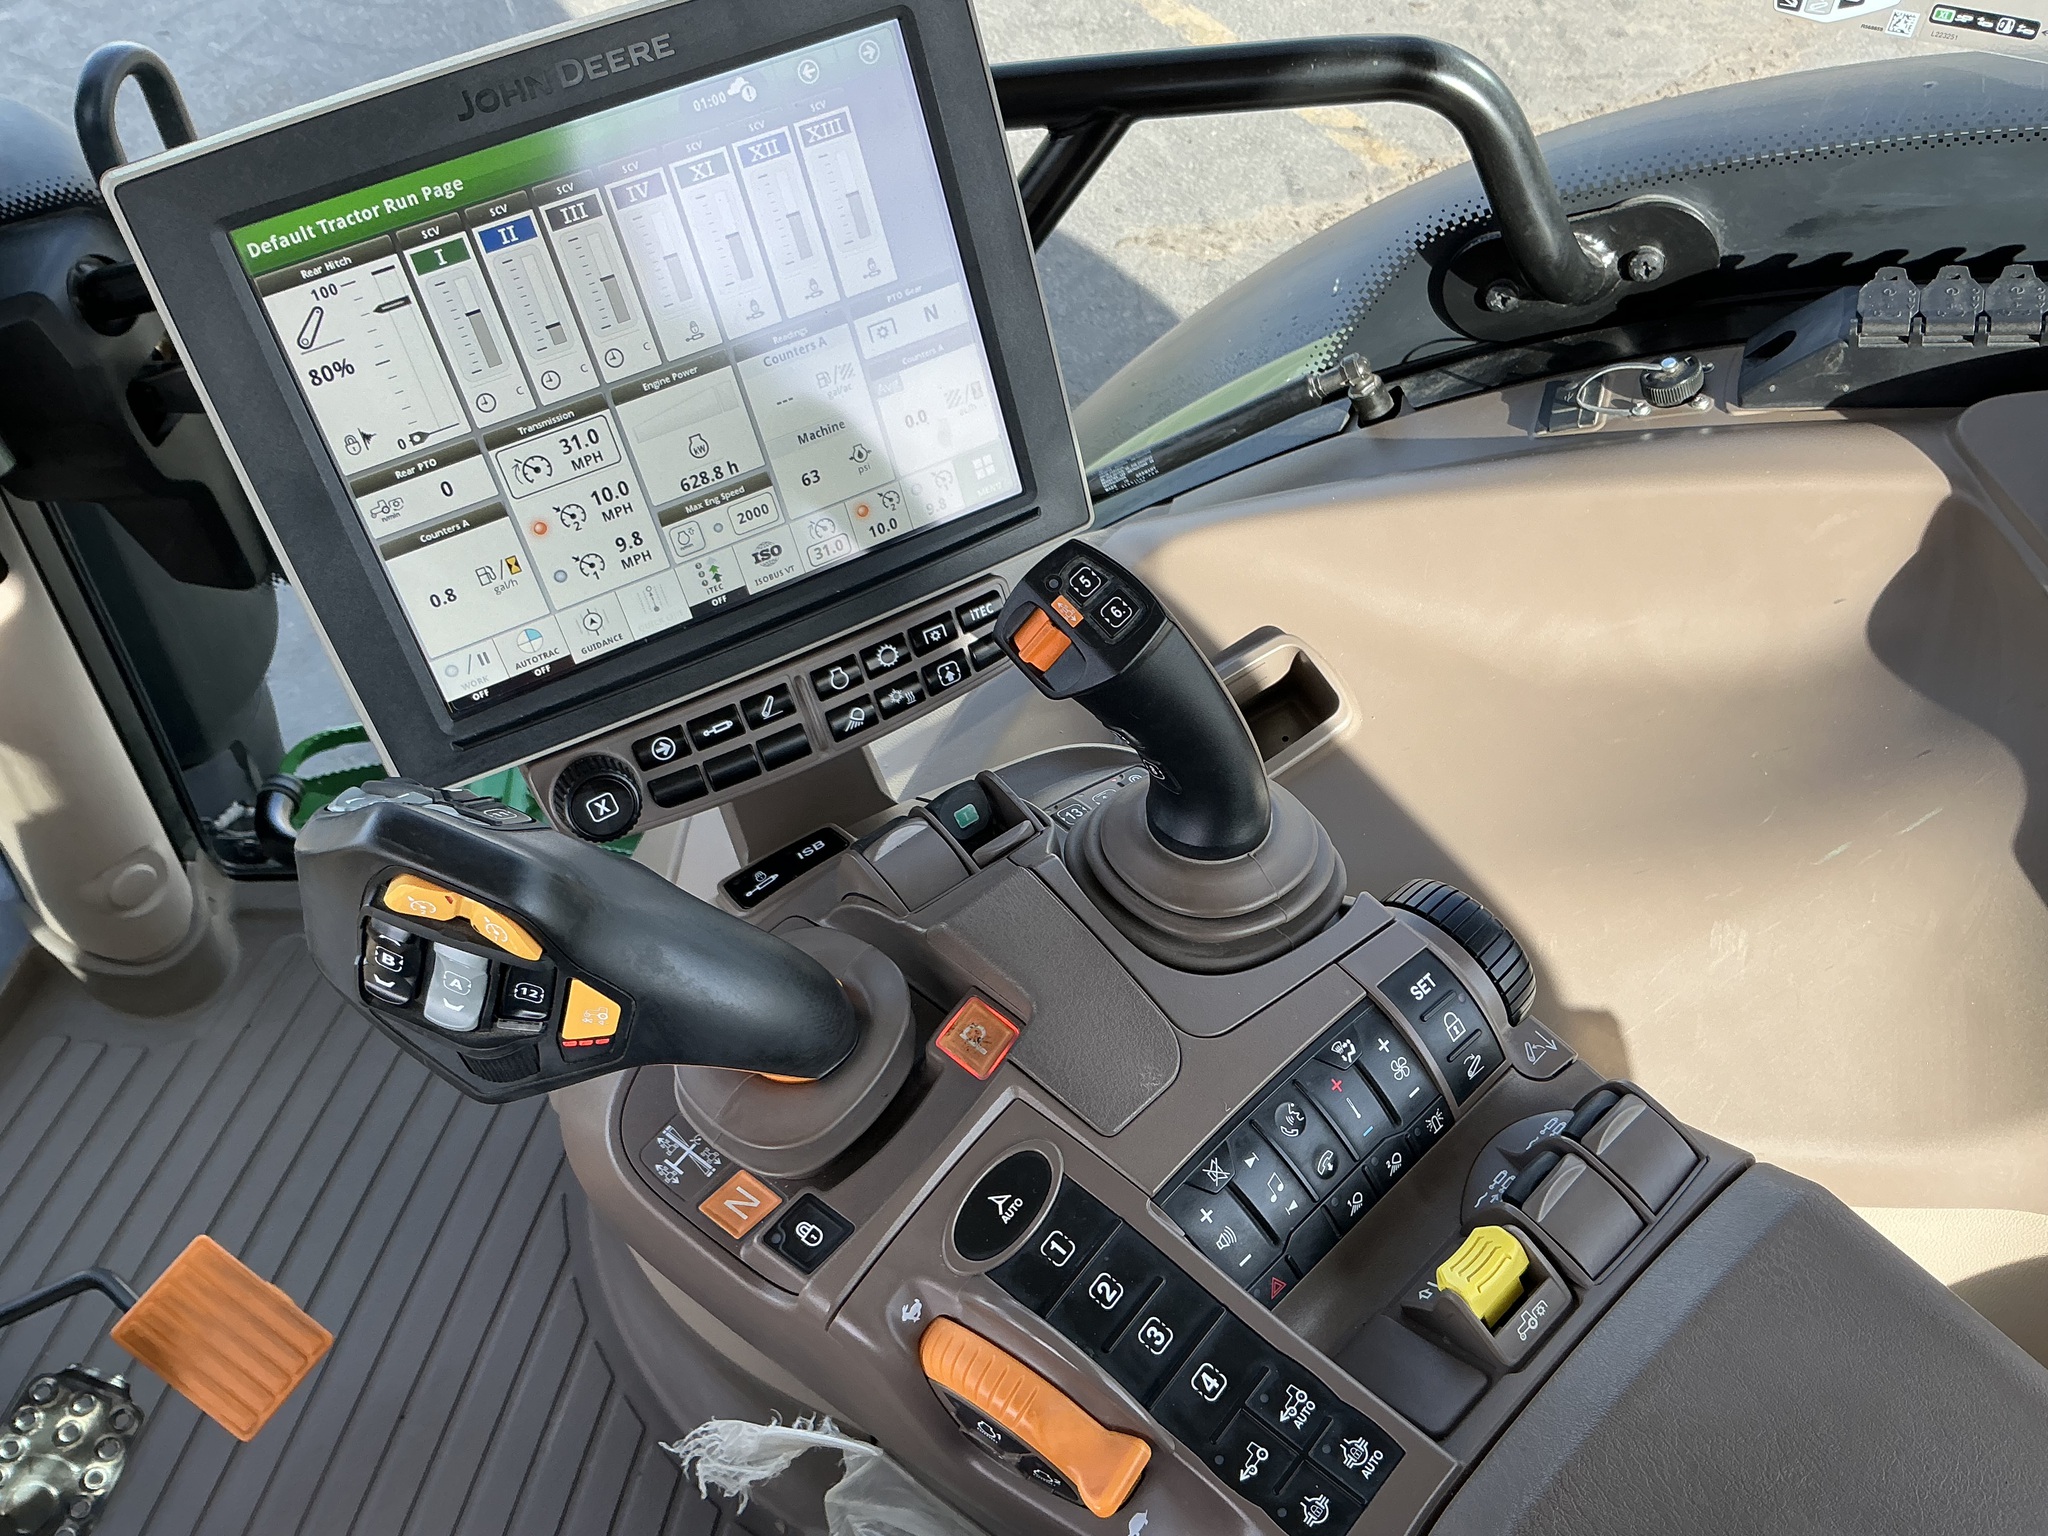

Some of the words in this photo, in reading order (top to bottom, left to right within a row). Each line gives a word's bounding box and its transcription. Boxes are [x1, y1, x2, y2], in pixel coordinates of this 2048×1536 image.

[1930, 31, 1959, 41] L223251
[457, 72, 554, 122] JOHN
[557, 33, 675, 89] DEERE
[693, 91, 727, 112] 01:00
[810, 100, 826, 113] SCV
[748, 120, 765, 132] SCV
[805, 118, 843, 143] XIII
[686, 141, 703, 154] SCV
[748, 139, 780, 162] XII
[621, 161, 639, 174] SCV
[688, 160, 715, 182] XI
[556, 182, 574, 195] SCV
[625, 181, 649, 203] IV
[246, 219, 316, 258] Default
[316, 204, 380, 239] Tractor
[383, 191, 419, 215] Run
[421, 178, 464, 203] Page
[489, 203, 508, 217] SCV
[559, 201, 589, 225] III
[421, 226, 439, 239] SCV
[498, 225, 518, 245] II
[434, 248, 447, 266] I
[301, 261, 326, 280] Rear
[327, 255, 352, 272] Hitch
[311, 283, 338, 301] 100
[924, 304, 939, 322] N
[643, 342, 651, 351] C
[763, 342, 817, 367] Counters
[819, 337, 828, 348] A
[308, 358, 355, 386] 80%
[580, 363, 588, 373] C
[642, 375, 670, 392] Engine
[671, 365, 698, 382] Power
[516, 386, 524, 396] C
[517, 409, 575, 437] Transmission
[905, 410, 928, 428] 0.0
[558, 427, 600, 456] 31.0
[797, 419, 846, 446] Machine
[397, 438, 407, 450] 0
[693, 445, 706, 456] kW
[395, 466, 416, 480] Rear
[417, 459, 437, 471] PTO
[570, 450, 603, 473] MPH
[857, 462, 871, 476] psi
[680, 468, 723, 493] 628.8
[727, 460, 739, 475] h
[801, 469, 821, 487] 63
[440, 480, 454, 498] 0
[590, 480, 630, 507] 10.0
[685, 502, 703, 515] Max
[704, 493, 720, 509] Eng
[721, 485, 746, 505] Speed
[926, 498, 946, 515] 9.8
[601, 502, 634, 523] MPH
[736, 504, 769, 525] 2000
[419, 524, 460, 545] Counters
[461, 519, 471, 530] A
[868, 517, 898, 539] 10.0
[615, 531, 644, 554] 9.8
[813, 539, 844, 560] 31.0
[620, 549, 653, 571] MPH
[751, 544, 783, 565] ISO
[755, 570, 784, 586] ISOBUS
[784, 565, 796, 574] VT
[1079, 575, 1091, 588] 5
[493, 577, 519, 596] gal/h
[429, 588, 458, 609] 0.8
[711, 595, 727, 606] OFF
[970, 604, 994, 621] iTEC
[580, 633, 624, 656] GUIDANCE
[514, 647, 560, 671] AUTOTRAC
[534, 664, 551, 677] OFF
[460, 674, 490, 691] WORK
[472, 688, 490, 701] OFF
[595, 799, 611, 816] X
[1064, 808, 1083, 820] 13
[797, 840, 825, 859] ISB
[381, 951, 397, 967] B
[450, 979, 463, 991] A
[520, 987, 539, 999] 12
[1410, 972, 1437, 1001] SET
[723, 1186, 761, 1220] N
[1000, 1198, 1024, 1225] AUTO
[1050, 1240, 1067, 1256] 1
[1097, 1282, 1117, 1301] 2
[1147, 1328, 1165, 1344] 3
[1203, 1374, 1219, 1391] 4
[1294, 1400, 1317, 1430] AUTO
[1361, 1450, 1384, 1480] AUTO
